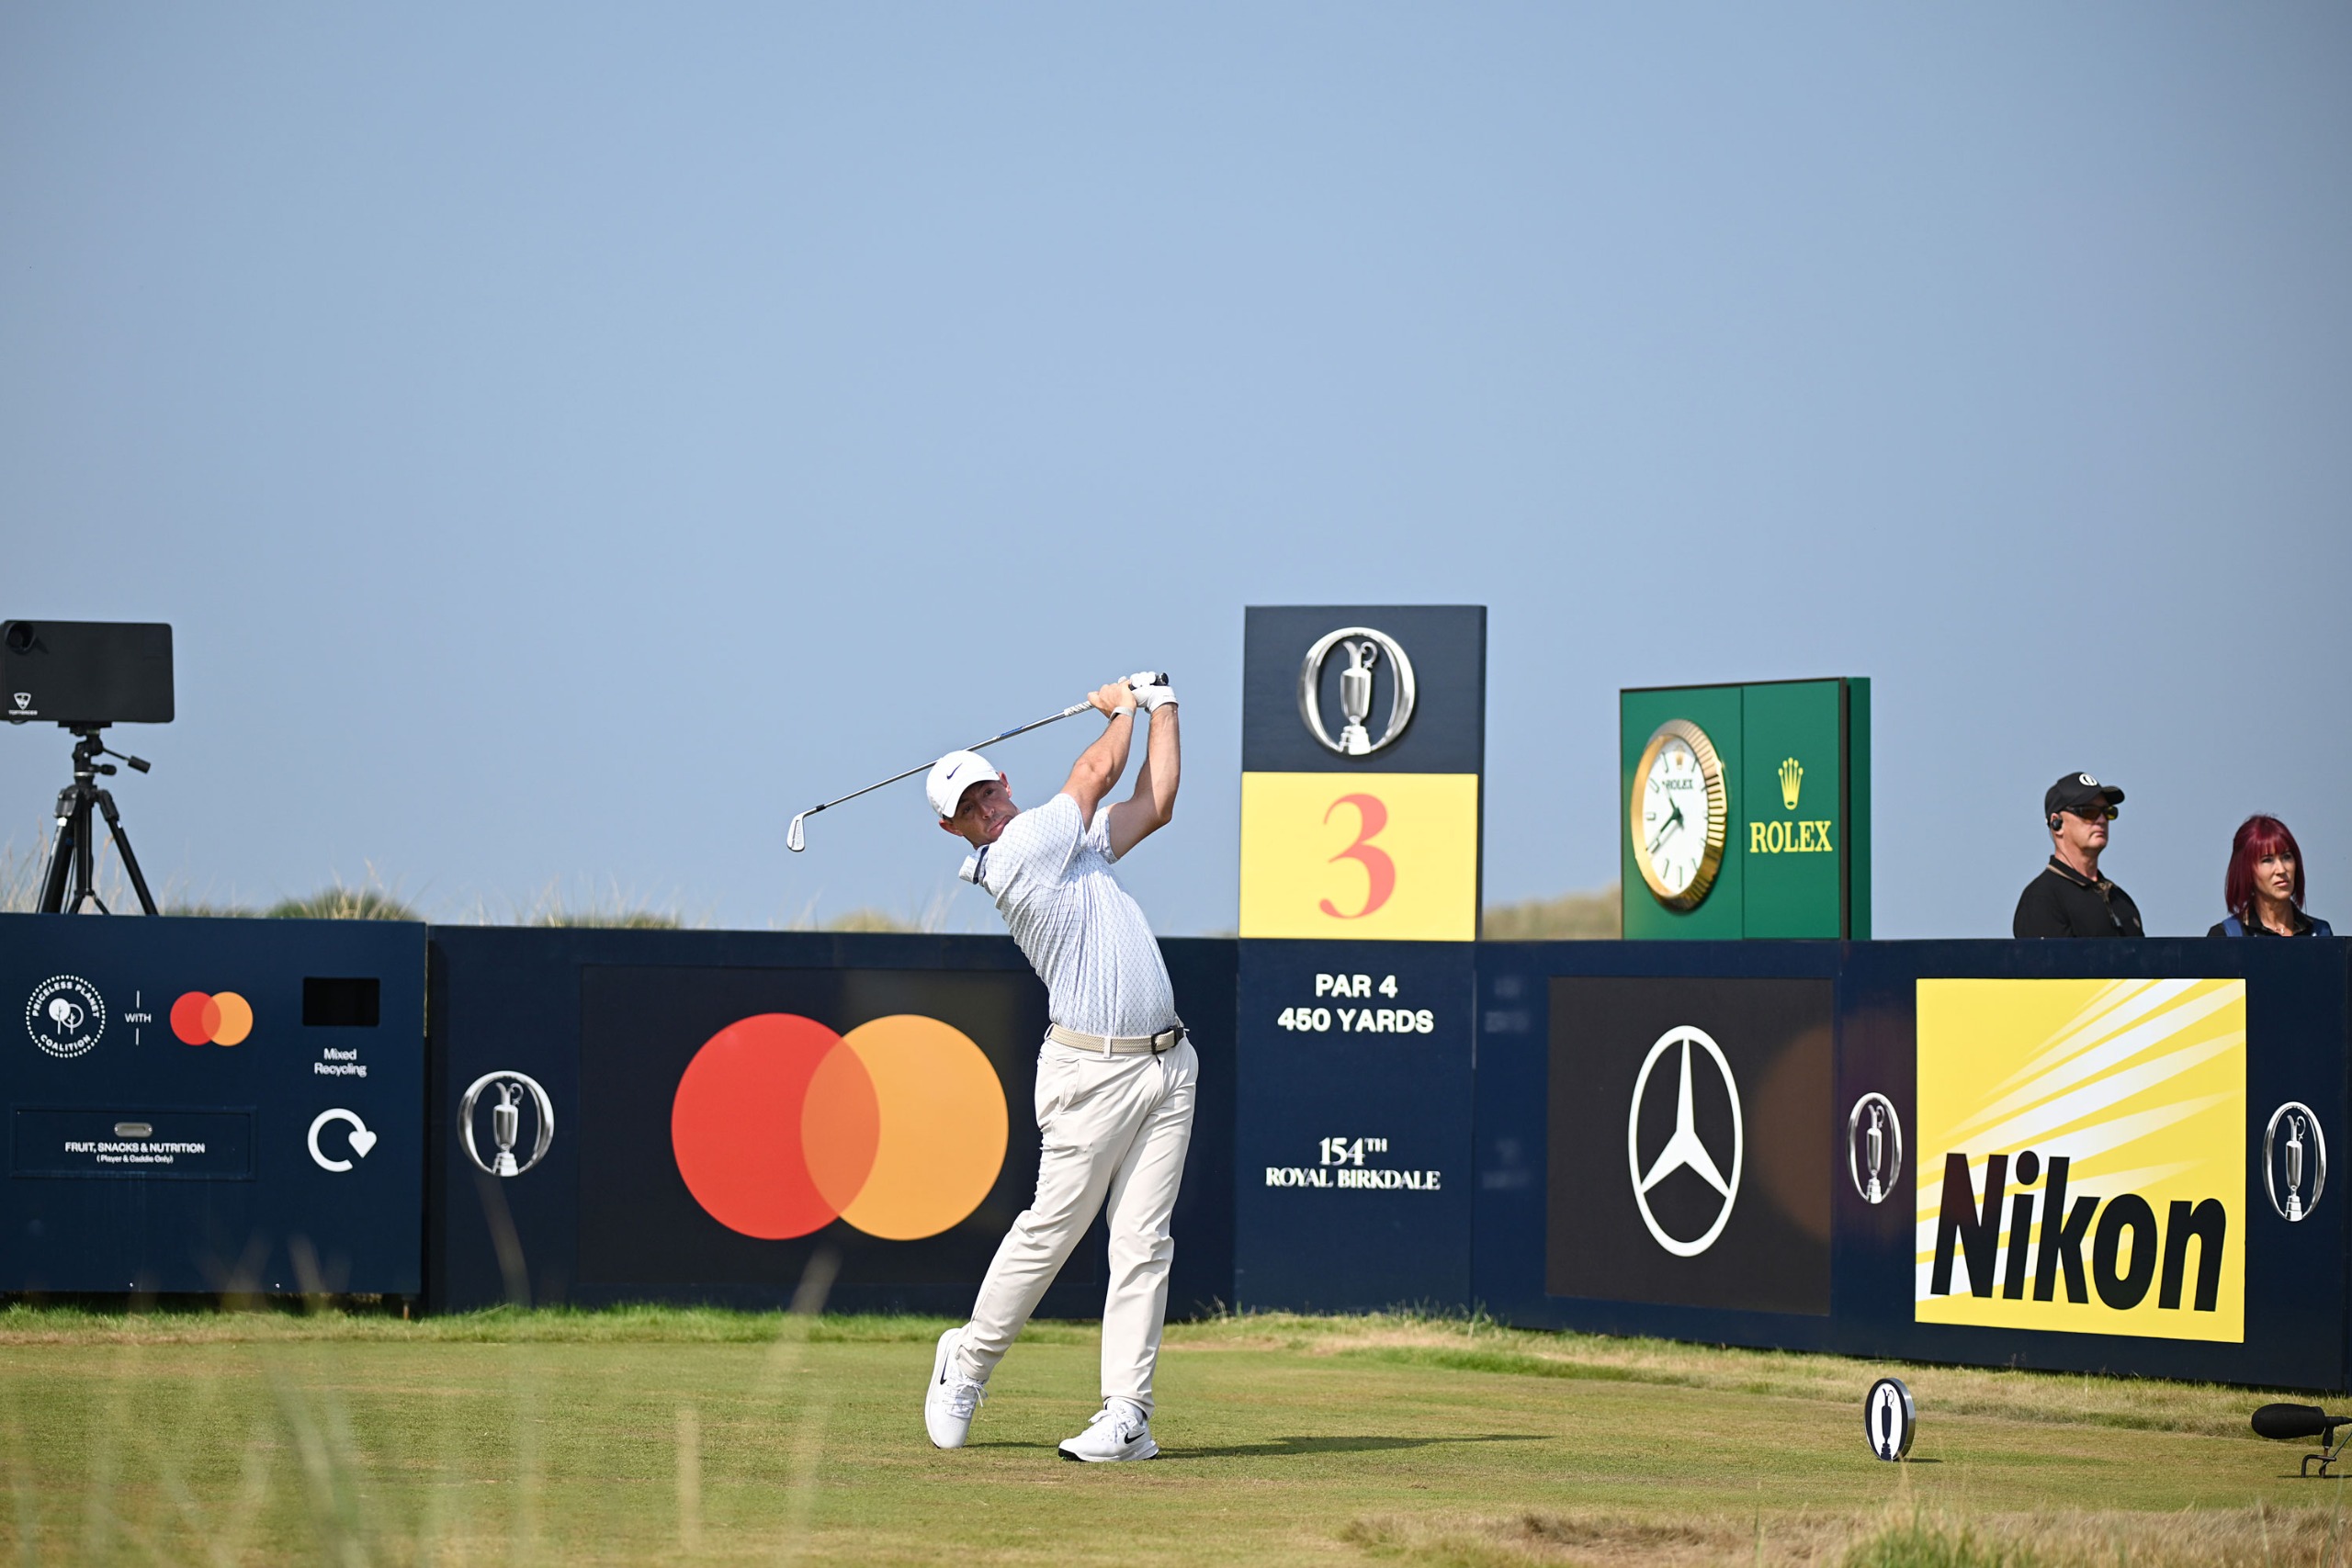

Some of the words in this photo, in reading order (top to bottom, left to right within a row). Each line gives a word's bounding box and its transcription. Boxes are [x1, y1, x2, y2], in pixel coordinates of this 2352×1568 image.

[1749, 820, 1833, 854] ROLEX
[1319, 793, 1396, 919] 3
[1315, 974, 1372, 998] PAR
[1378, 975, 1399, 998] 4
[32, 981, 73, 1017] PRICELESS
[74, 984, 100, 1018] PLANET
[124, 1012, 152, 1024] WITH
[1277, 1007, 1331, 1032] 450
[1337, 1009, 1435, 1033] YARDS
[40, 1033, 91, 1052] COALITION
[323, 1047, 357, 1060] Mixed
[314, 1062, 368, 1077] Recycling
[65, 1142, 96, 1154] FRUIT,
[97, 1142, 139, 1153] SNACKS
[141, 1143, 149, 1153] &
[150, 1143, 206, 1154] NUTRITION
[123, 1155, 129, 1163] &
[130, 1155, 153, 1163] Caddie
[154, 1155, 174, 1164] Only)
[1318, 1137, 1388, 1166] 154TH
[1266, 1168, 1334, 1188] ROYAL
[1338, 1169, 1441, 1190] BIRKDALE
[1930, 1150, 2227, 1312] Nikon
